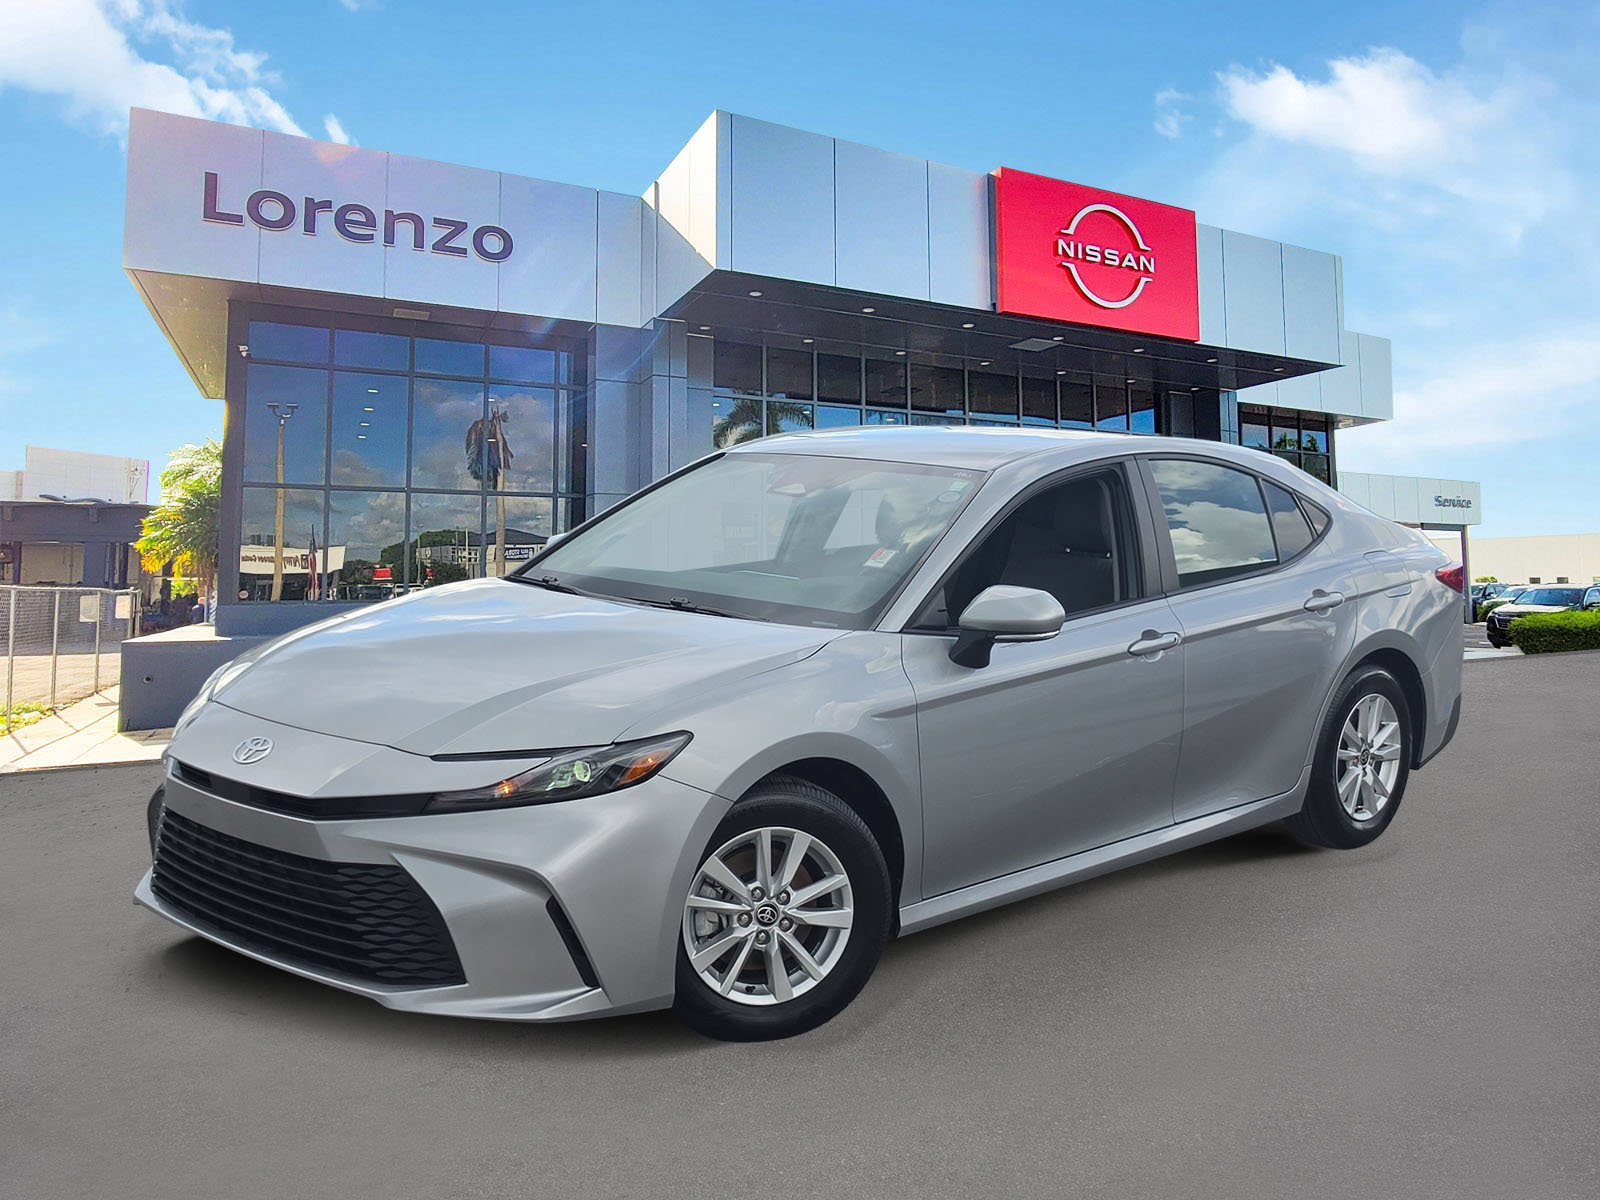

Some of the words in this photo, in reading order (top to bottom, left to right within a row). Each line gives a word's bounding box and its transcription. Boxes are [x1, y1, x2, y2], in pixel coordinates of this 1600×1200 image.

[202, 171, 514, 262] Lorenzo
[1057, 238, 1155, 273] NISSAN
[1434, 495, 1472, 508] Service
